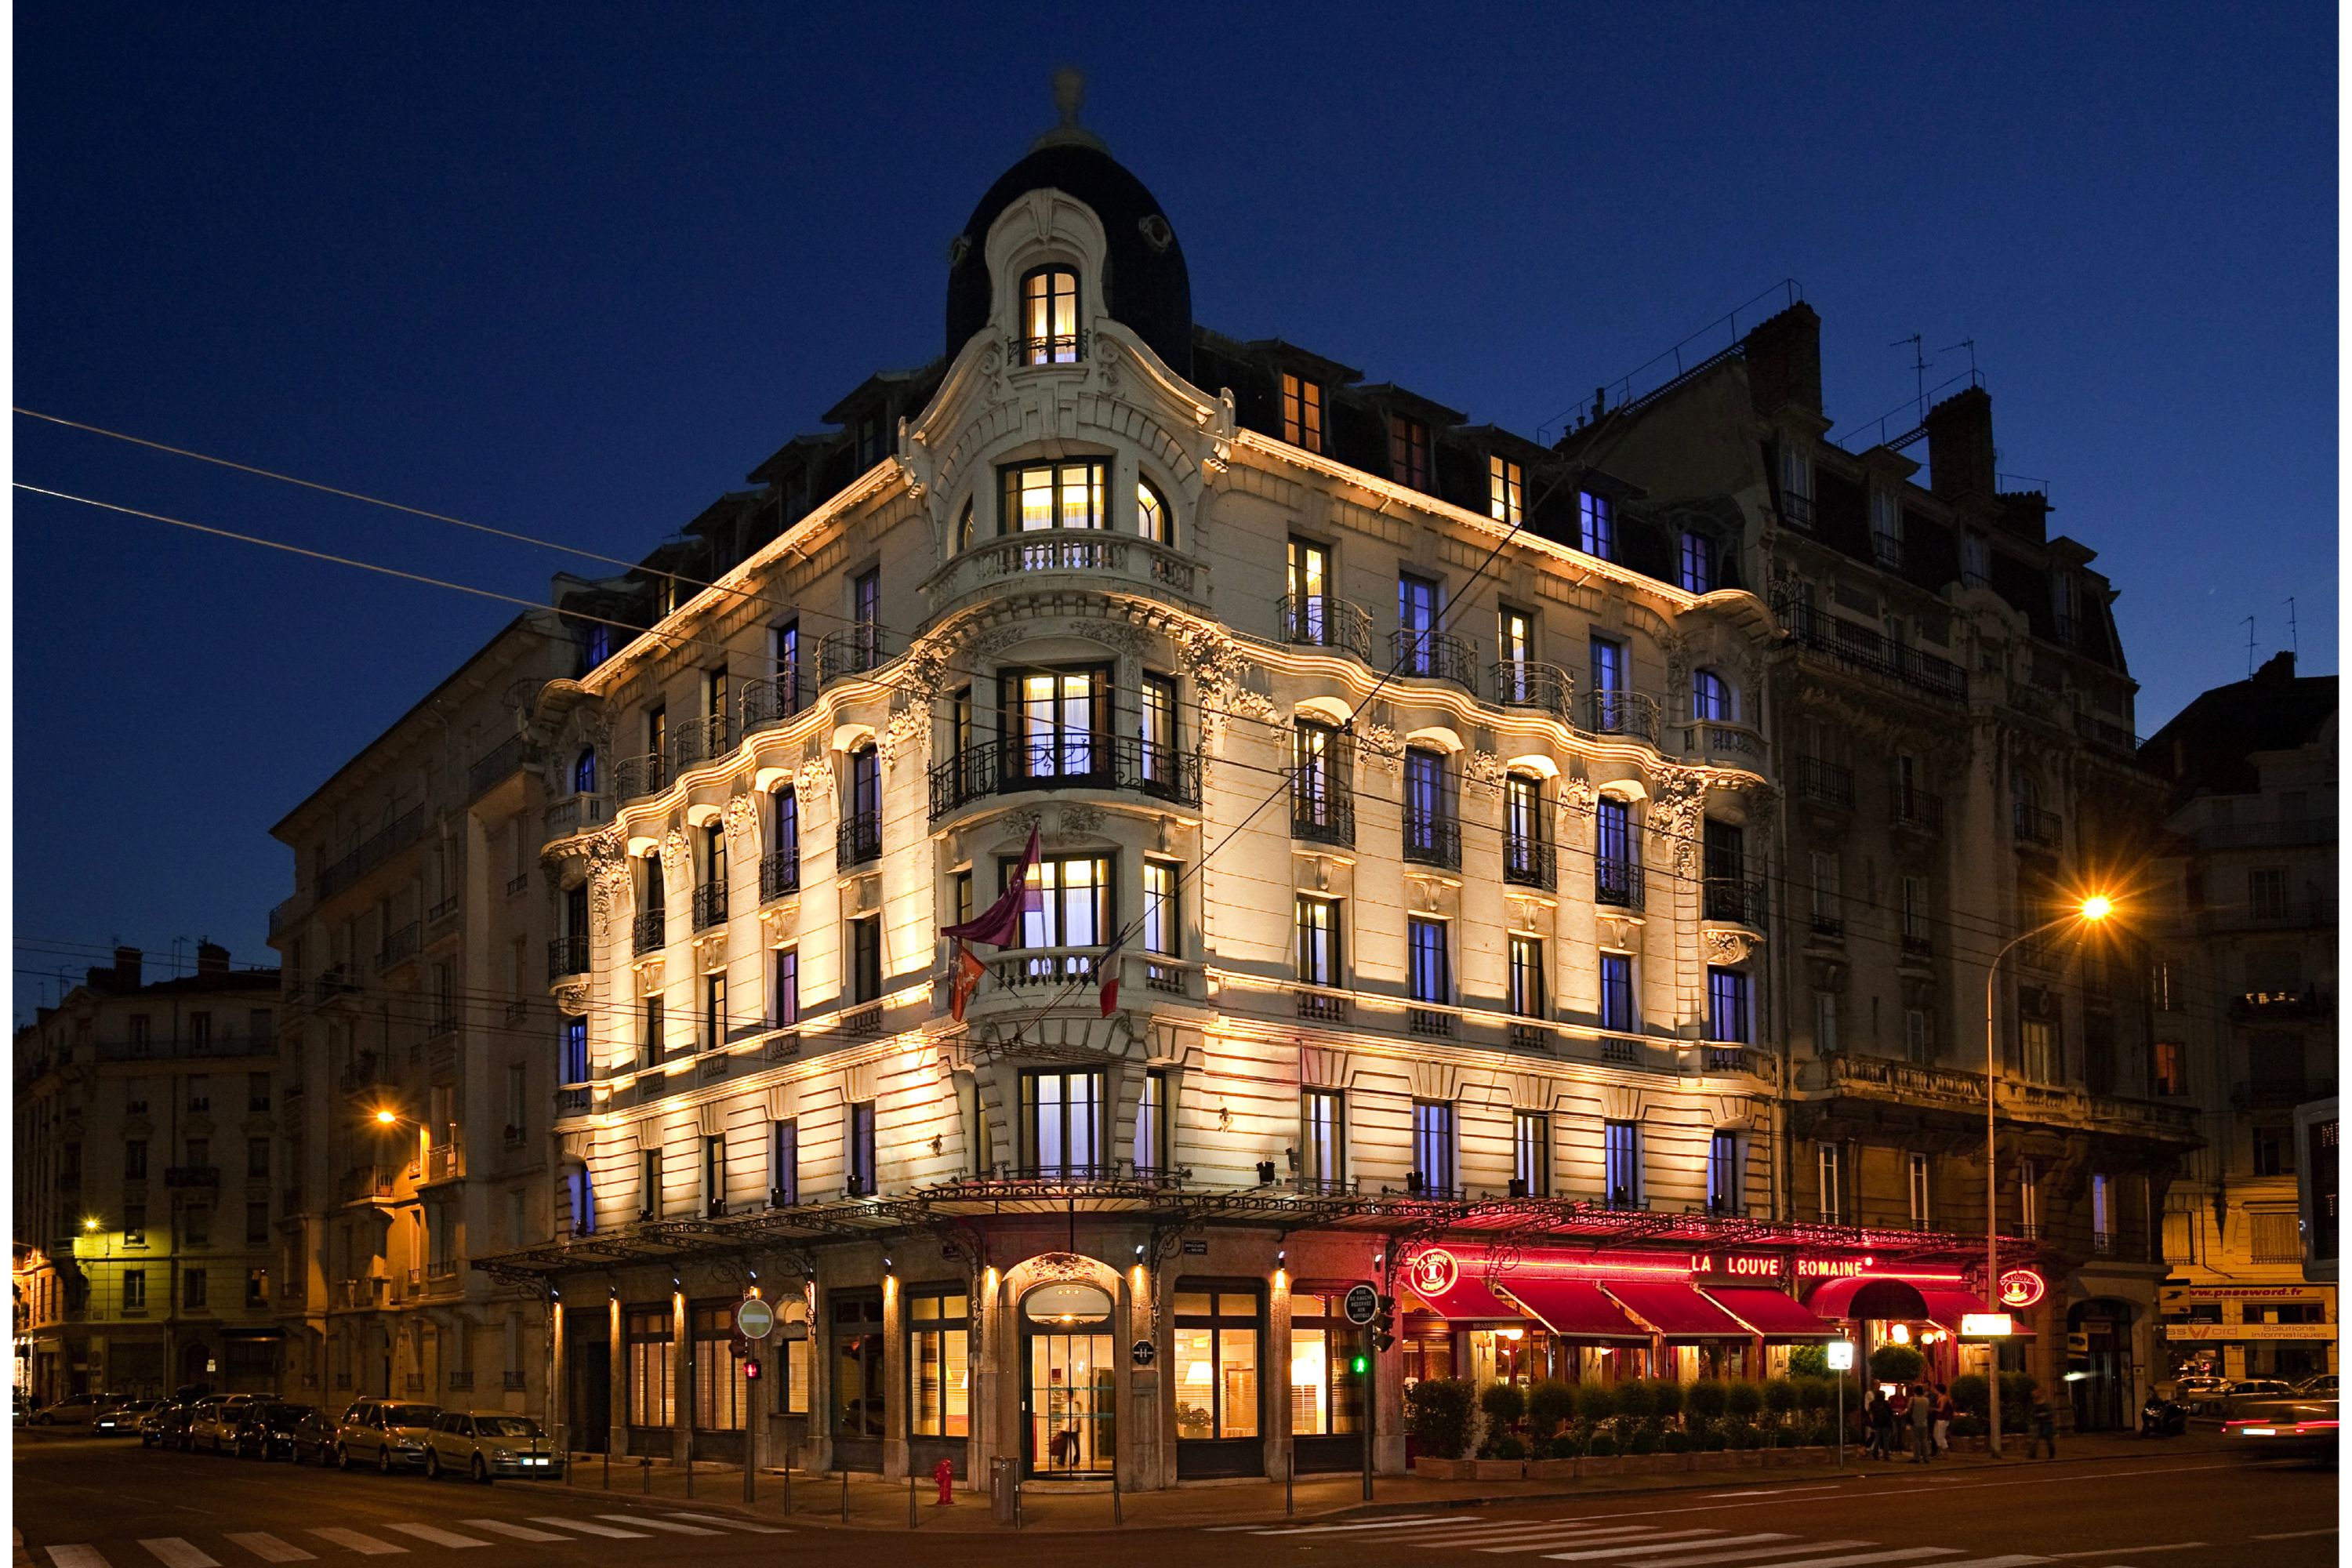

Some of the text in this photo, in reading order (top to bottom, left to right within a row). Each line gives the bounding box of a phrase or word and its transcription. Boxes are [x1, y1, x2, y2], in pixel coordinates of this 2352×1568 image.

[1417, 1254, 1448, 1270] LA LOUVE
[1691, 1255, 1863, 1277] LA LOUVE ROMAINE
